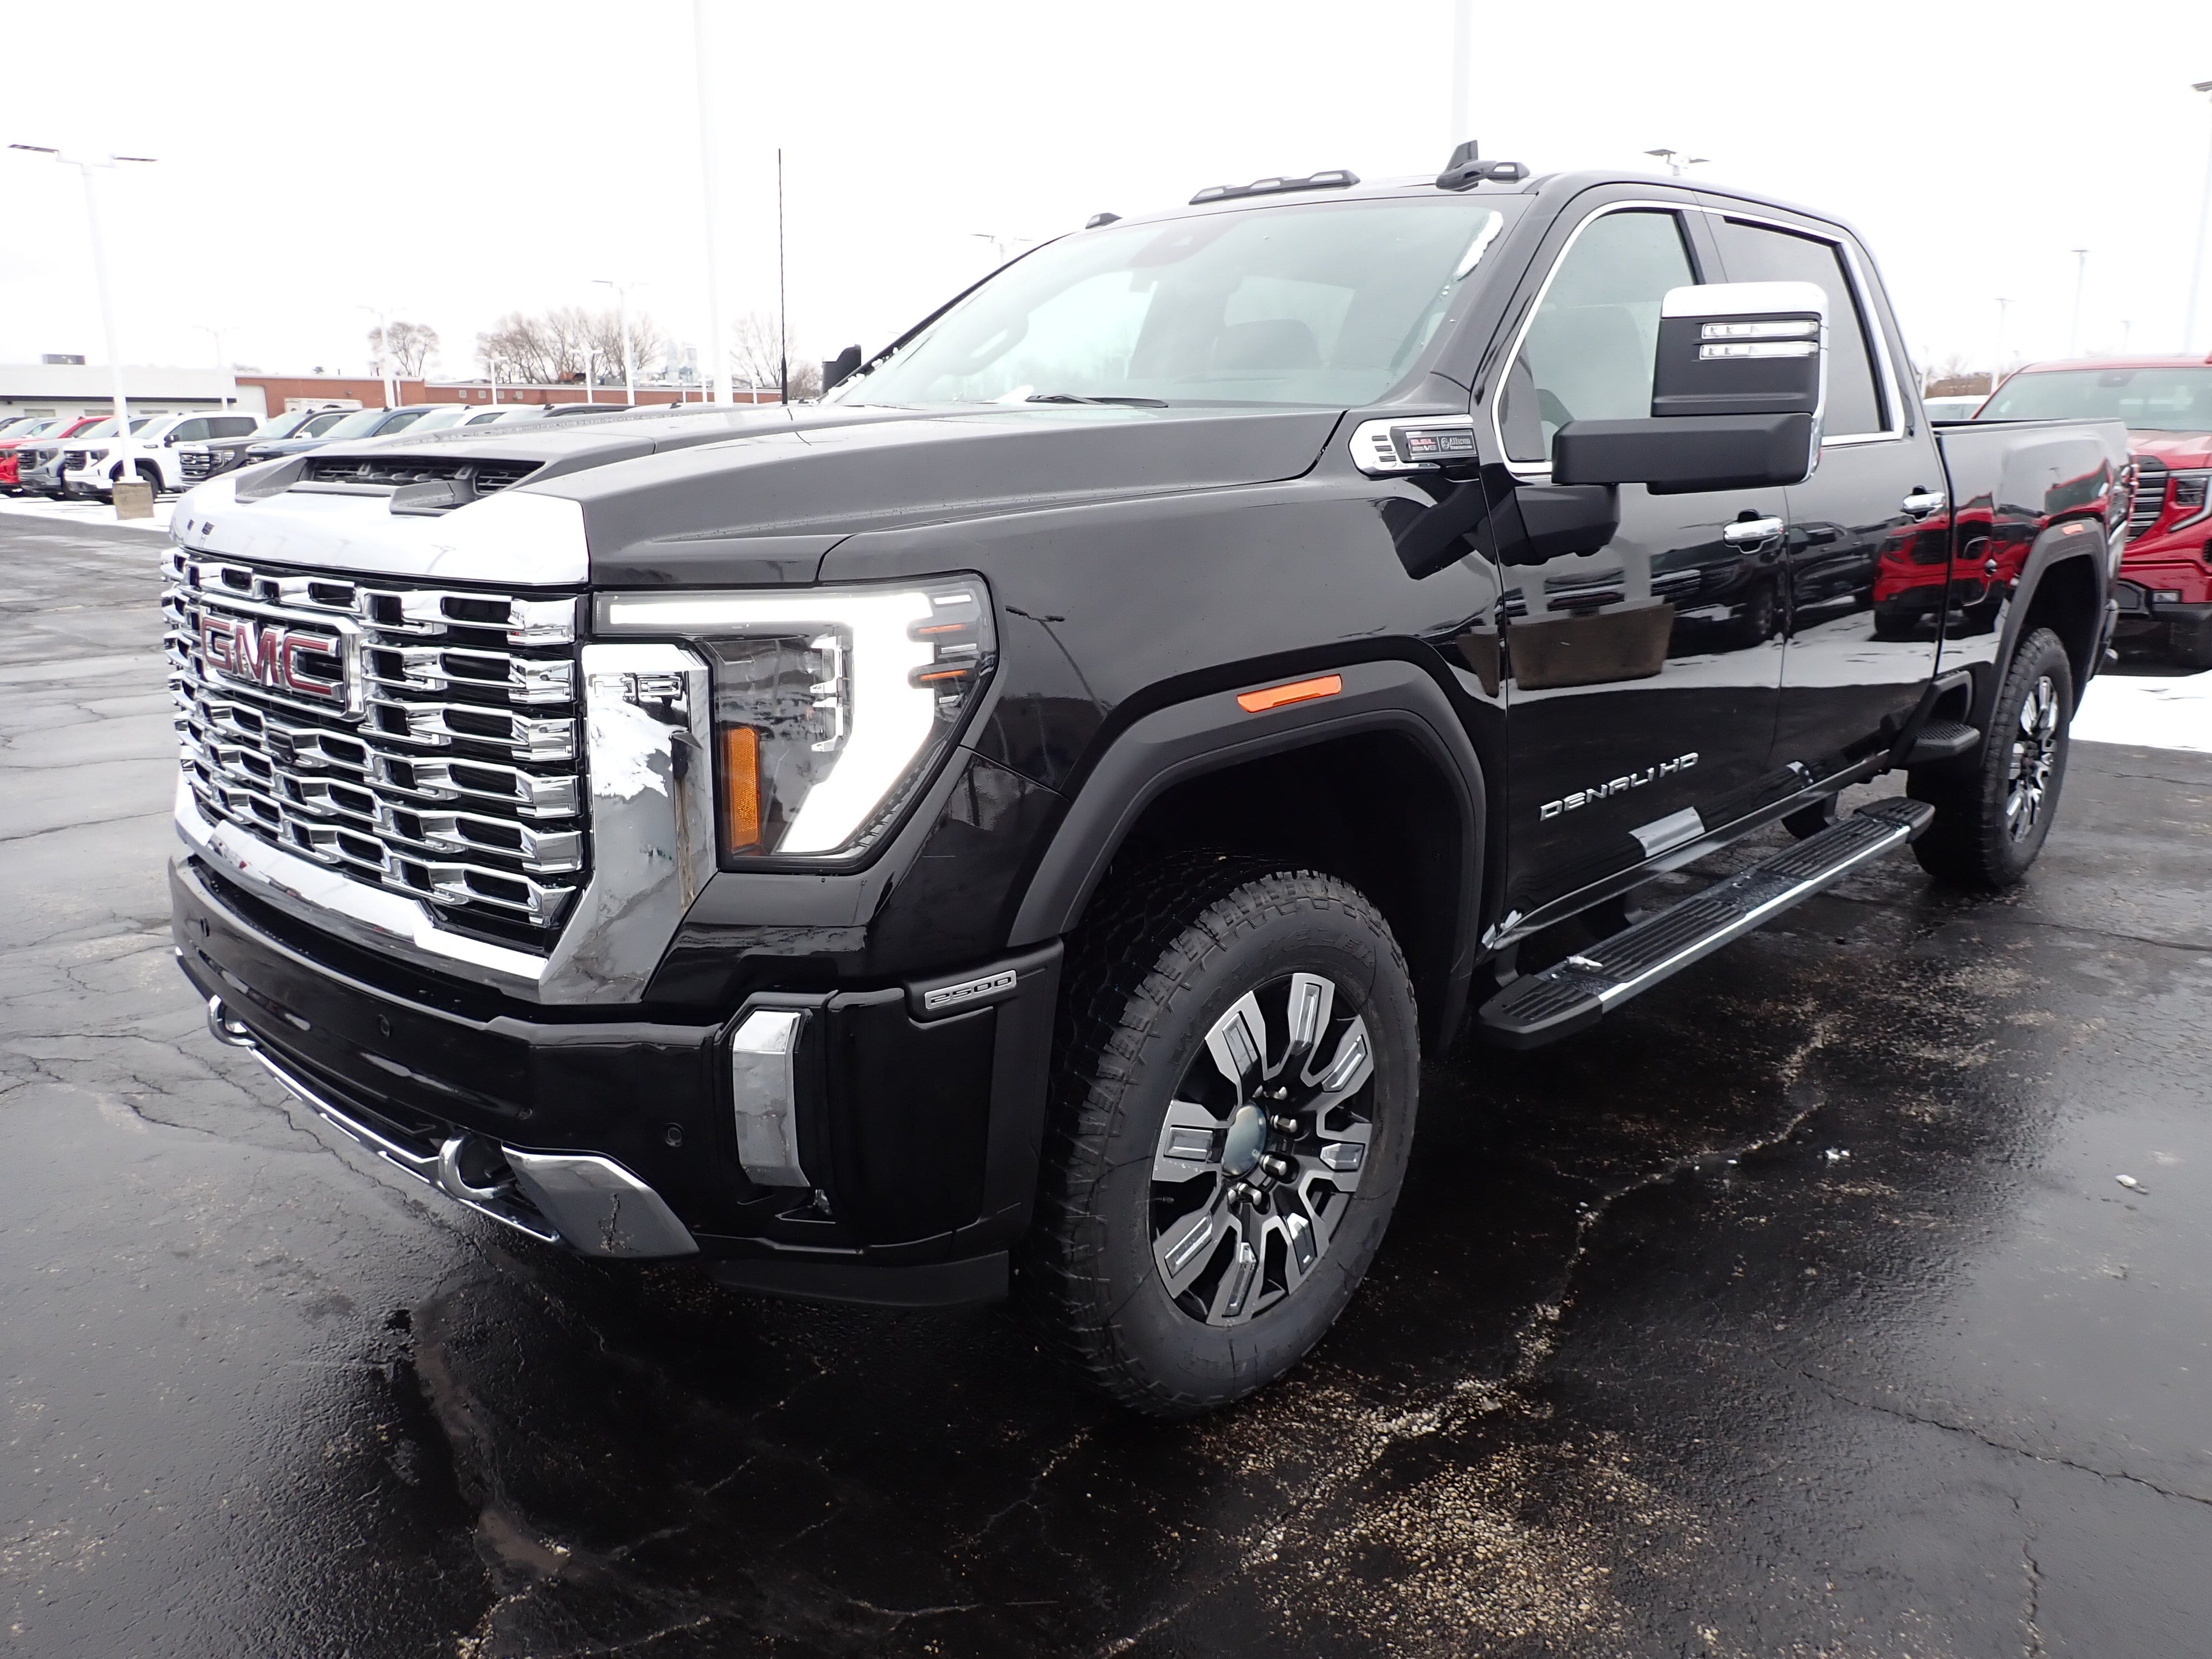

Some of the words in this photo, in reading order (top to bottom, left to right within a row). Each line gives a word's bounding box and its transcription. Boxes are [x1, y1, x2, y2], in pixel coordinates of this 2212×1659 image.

[201, 614, 343, 702] GMC
[1540, 766, 1655, 821] DENALI
[1659, 752, 1699, 778] HD
[930, 975, 1012, 1005] 2500
